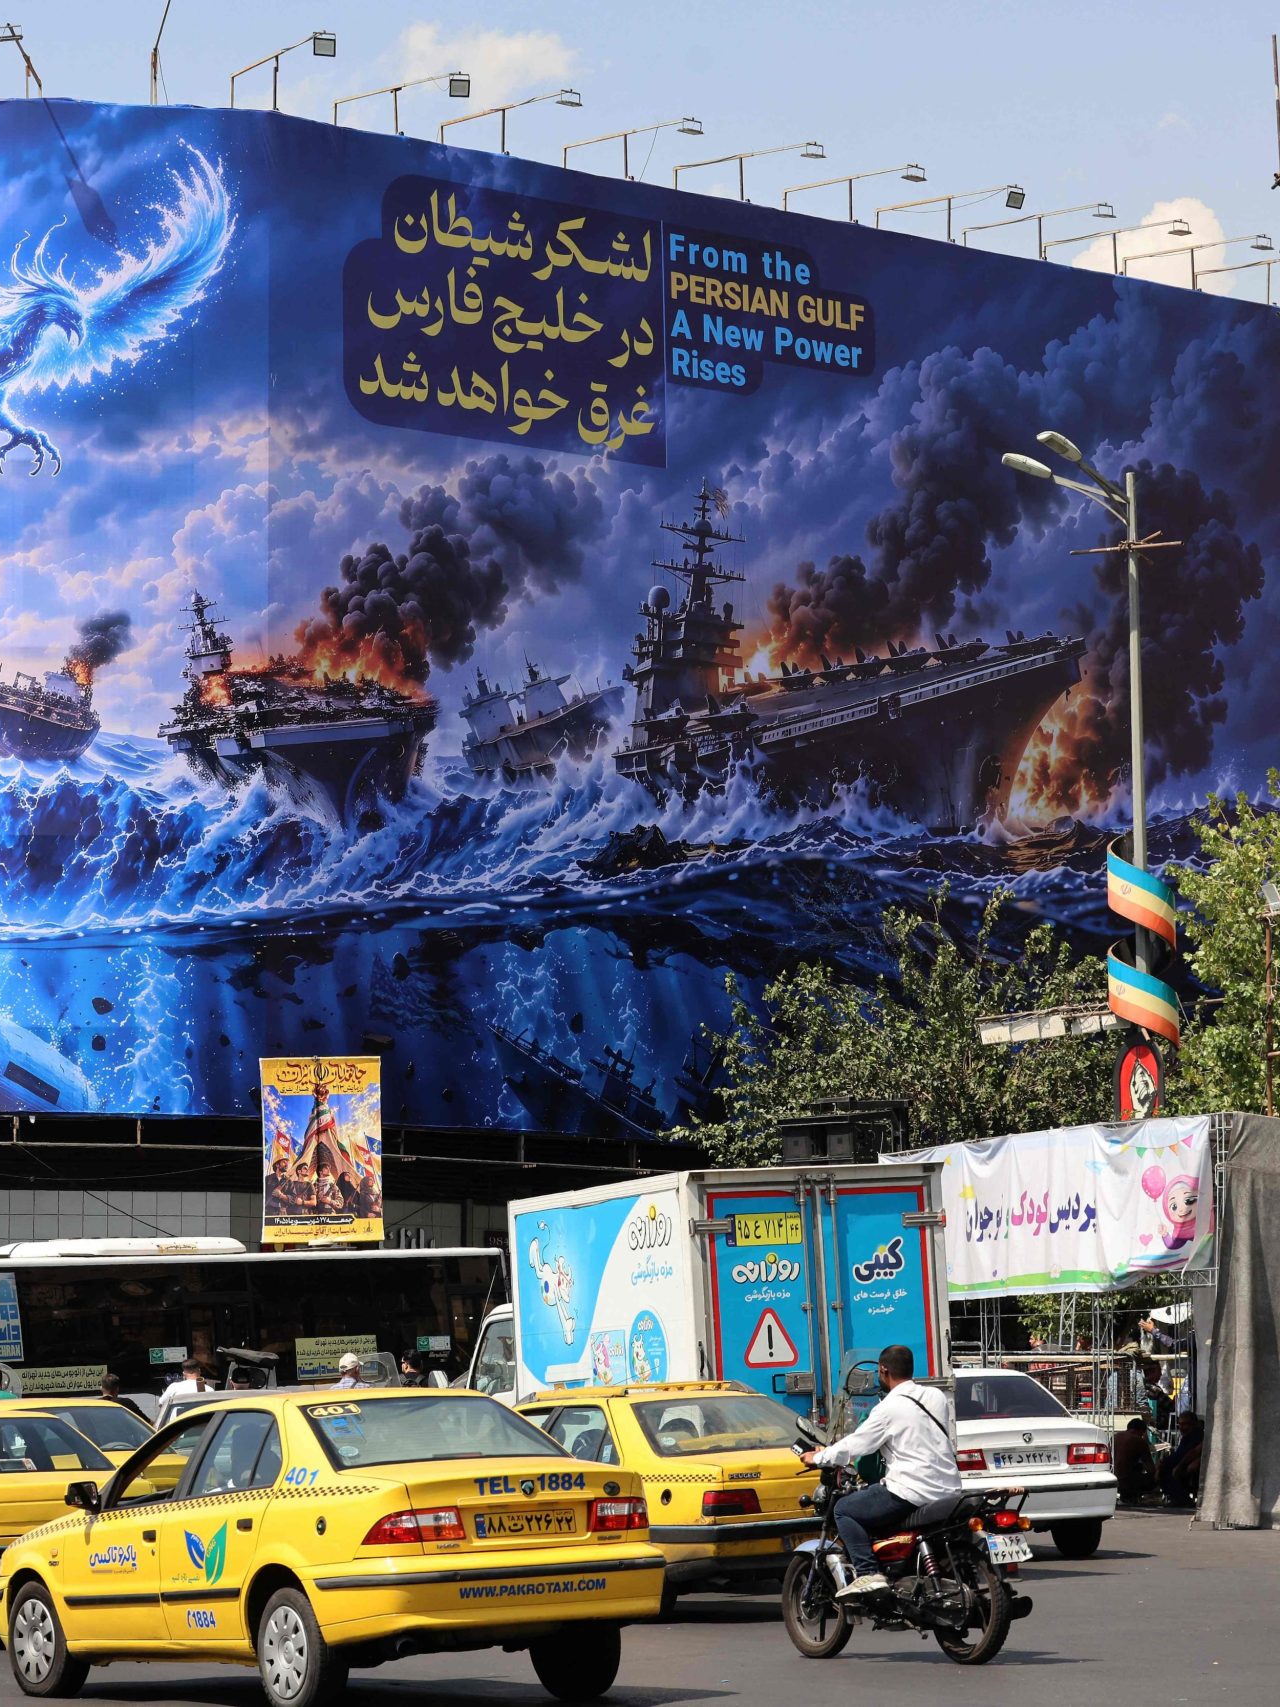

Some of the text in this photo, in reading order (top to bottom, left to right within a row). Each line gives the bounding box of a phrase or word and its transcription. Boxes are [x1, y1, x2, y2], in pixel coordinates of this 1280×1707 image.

[394, 188, 652, 283] لشکر شیطان
[669, 233, 812, 286] From the
[670, 272, 866, 332] PERSIAN GULF
[367, 266, 654, 368] در خلیج فارس
[671, 309, 863, 370] A New Power
[672, 347, 747, 387] Rises
[359, 351, 655, 450] غرق خواهد شد
[628, 1206, 673, 1251] روزانه
[965, 1189, 1097, 1243] پردیس کودک و نوجوان
[631, 1256, 673, 1286] مزه بازیگوشی
[732, 1252, 800, 1284] روزانه
[744, 1286, 791, 1302] مزه بازیگوشی
[853, 1292, 868, 1302] های
[869, 1290, 891, 1300] فرصت
[867, 1305, 895, 1316] خوشمزه
[313, 1403, 358, 1416] 401
[285, 1466, 320, 1486] 401
[474, 1472, 586, 1496] TEL 1884
[728, 1471, 762, 1480] PEUGEOT
[1003, 1535, 1020, 1547] ۱۶۶
[459, 1578, 607, 1599] WWW.PAKROTAXI.COM
[192, 1610, 216, 1628] 1884
